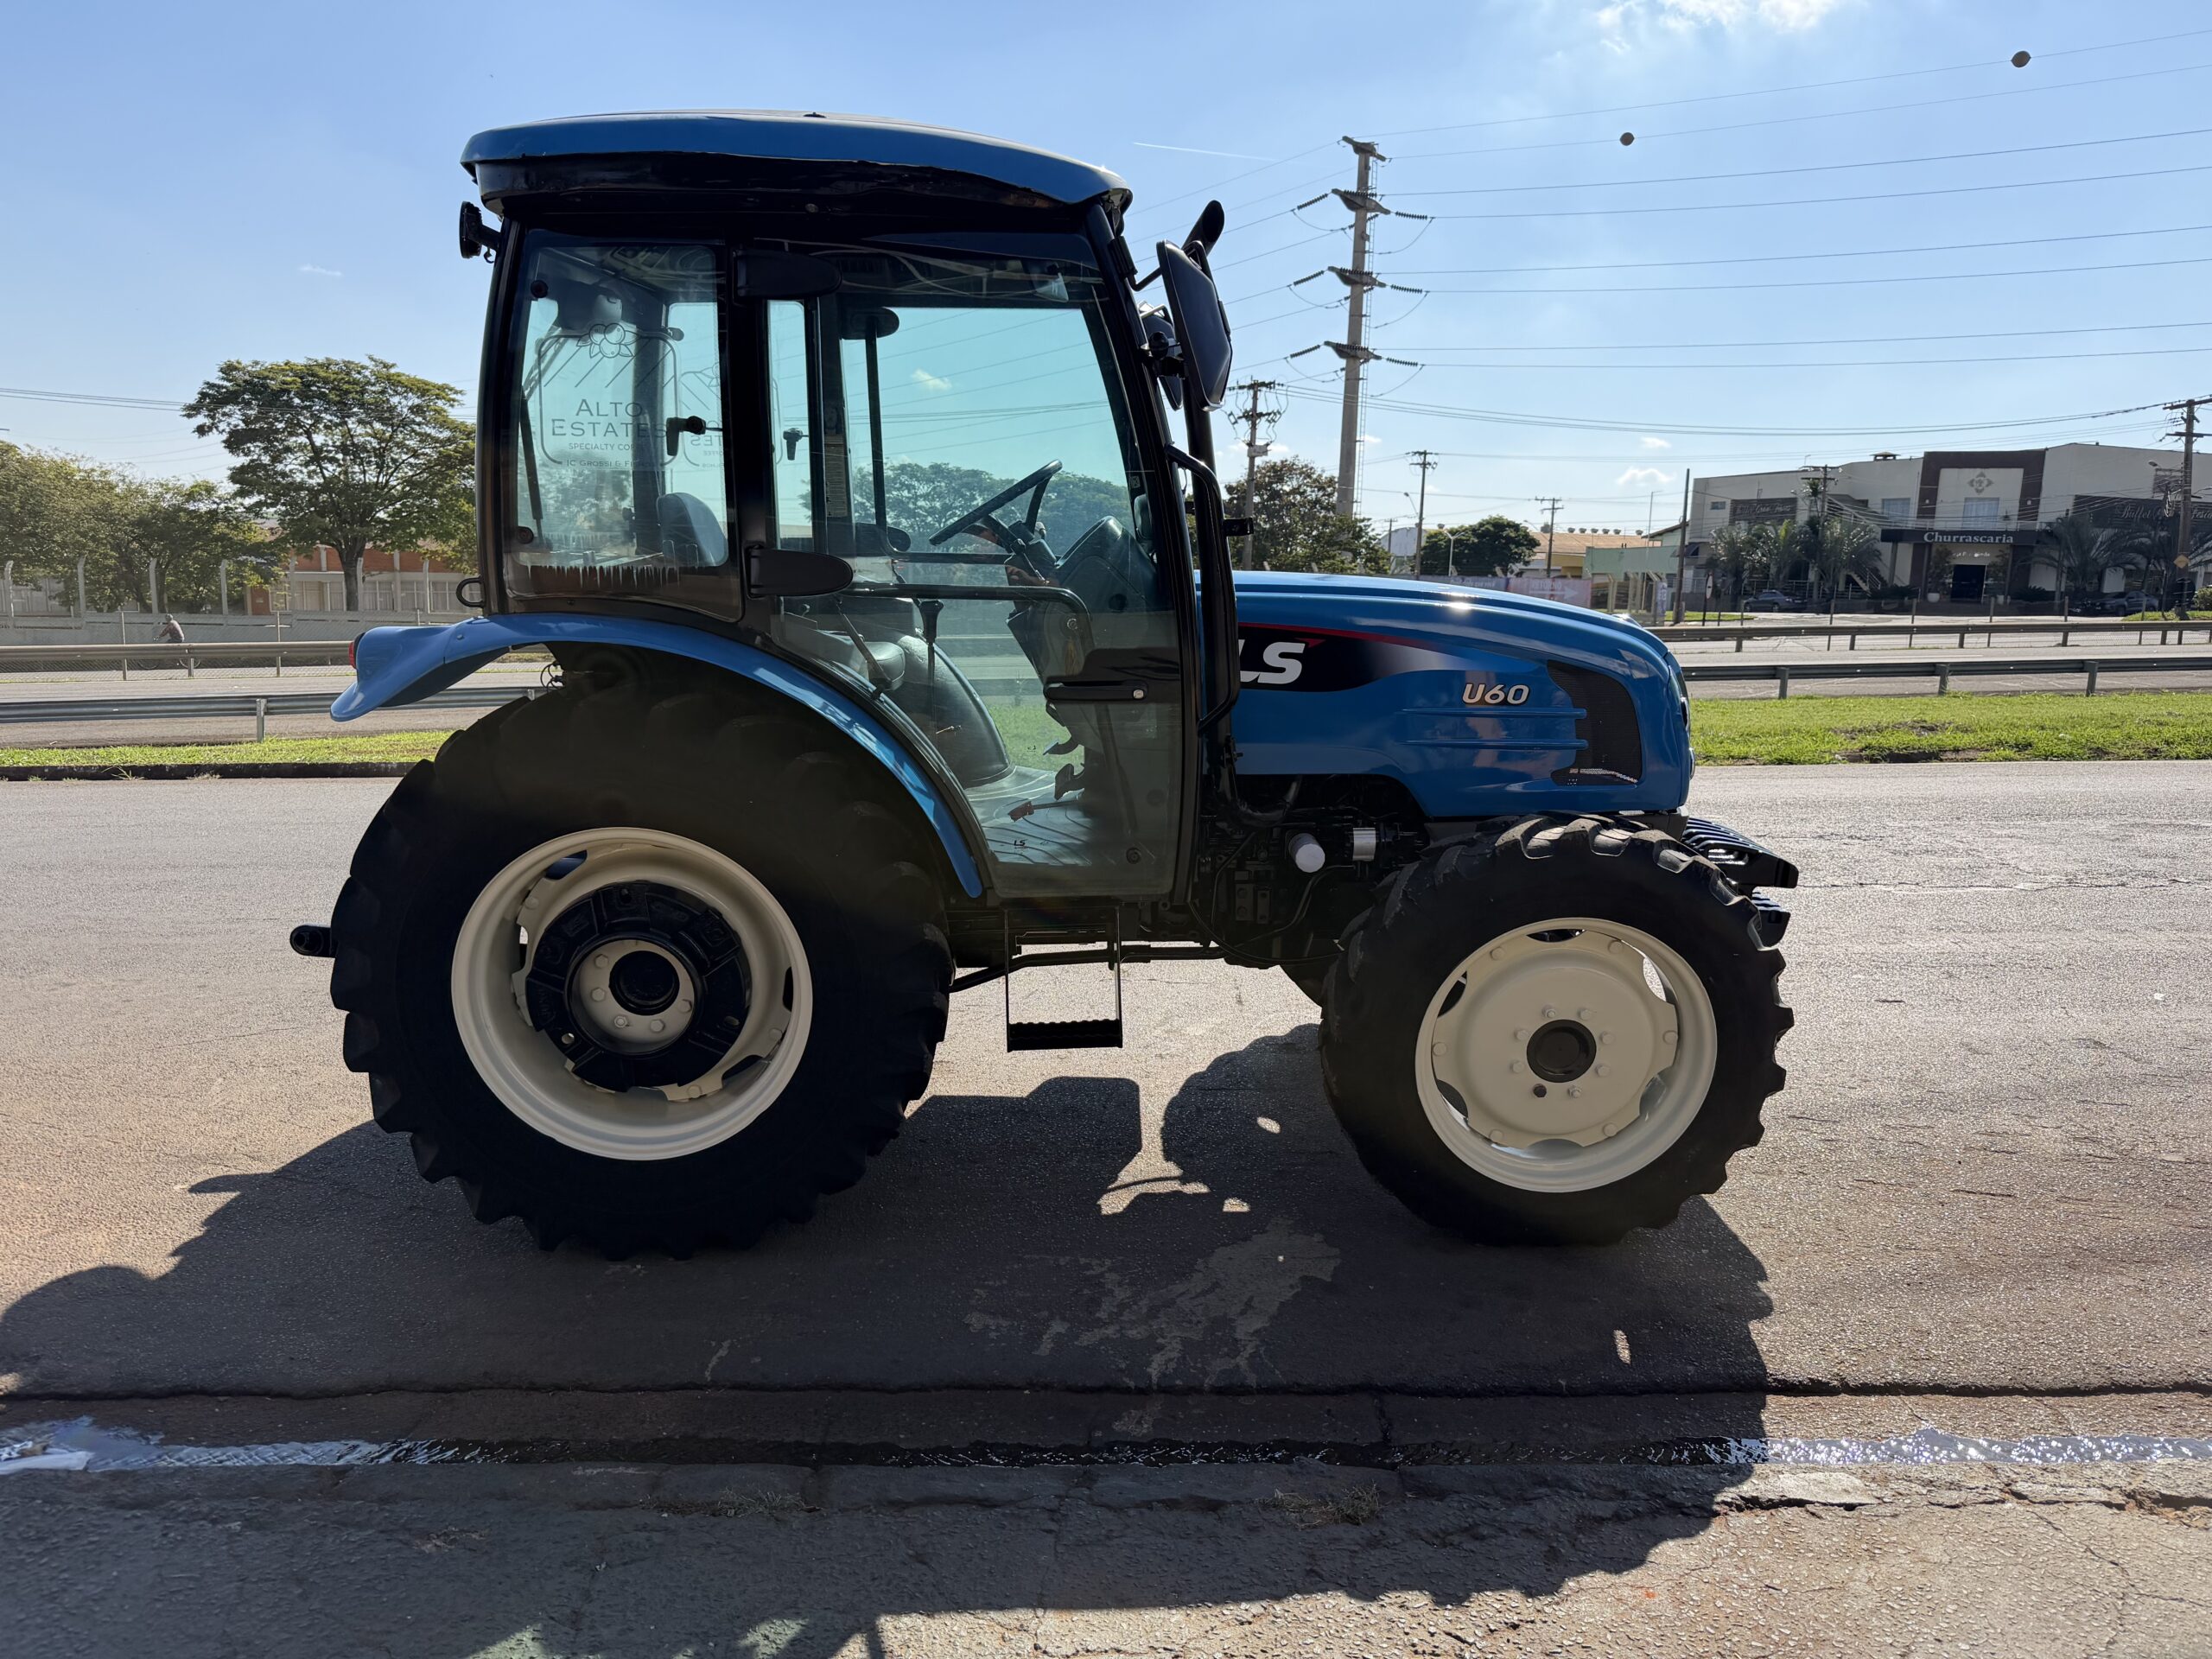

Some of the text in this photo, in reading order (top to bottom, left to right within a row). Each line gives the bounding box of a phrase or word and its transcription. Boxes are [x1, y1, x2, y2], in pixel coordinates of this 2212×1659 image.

[575, 398, 643, 417] ALTO
[551, 418, 666, 438] ESTATES
[569, 442, 616, 451] SPECIALTY
[1923, 532, 2014, 543] Churrascaria
[1238, 639, 1306, 684] S
[1462, 682, 1530, 705] U60
